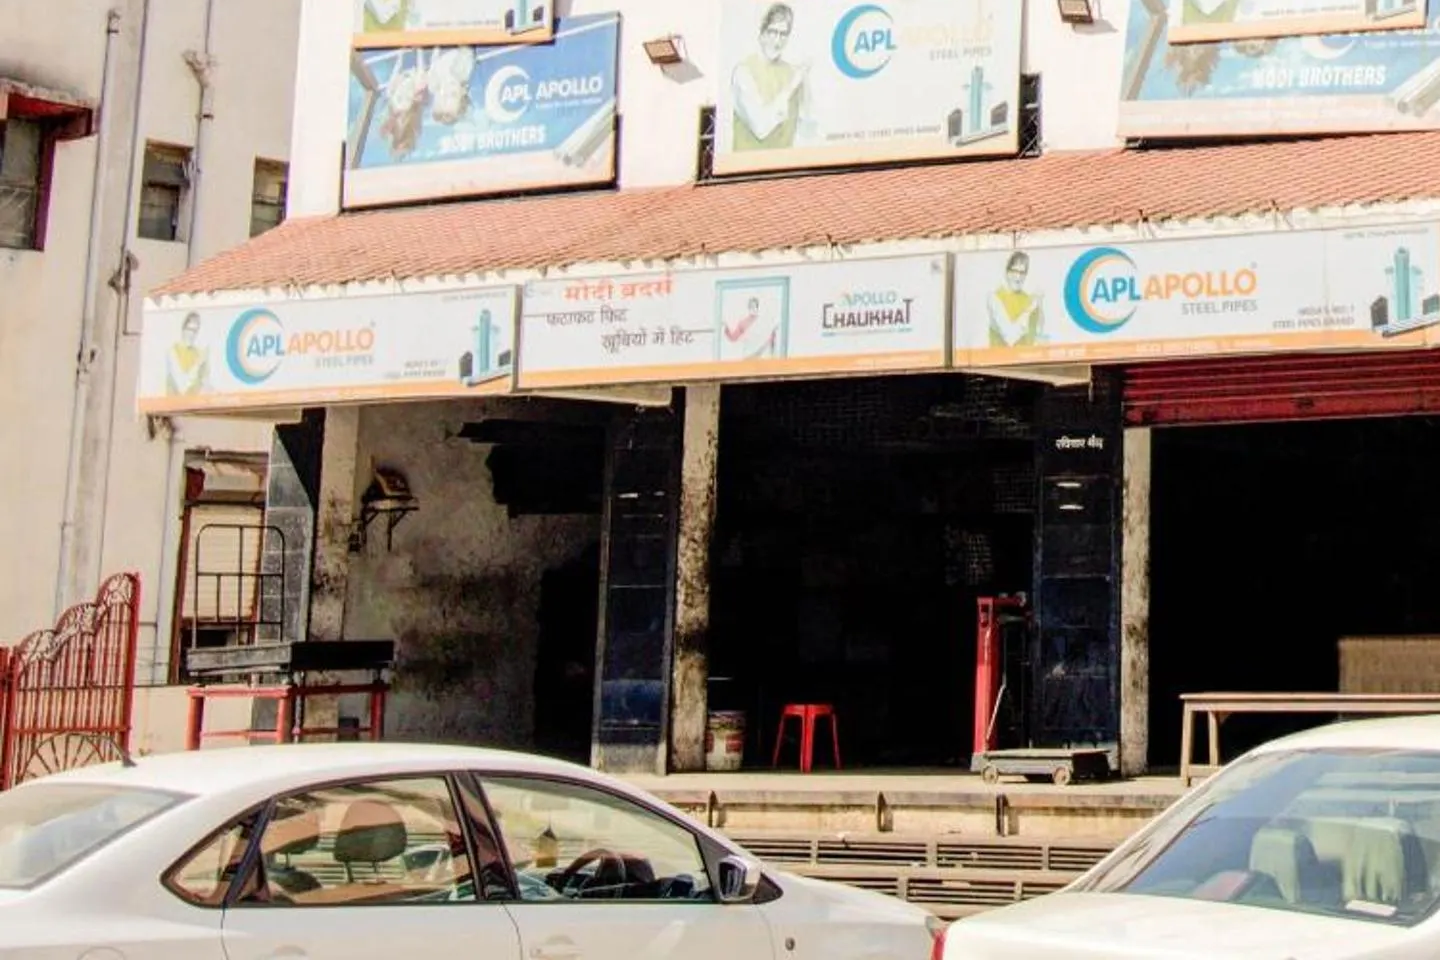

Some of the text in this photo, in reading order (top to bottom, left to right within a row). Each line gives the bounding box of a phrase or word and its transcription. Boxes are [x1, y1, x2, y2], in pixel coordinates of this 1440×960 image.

[853, 28, 897, 53] APL
[1300, 65, 1386, 86] BROTHERS
[502, 83, 532, 103] APL
[536, 76, 603, 99] APOLLO
[478, 125, 545, 150] BROTHERS
[564, 276, 613, 302] मोदी
[841, 289, 898, 307] APOLLO
[1090, 267, 1258, 304] APL APOLLO
[822, 299, 914, 329] CHAUKHAT
[1181, 300, 1258, 316] STEEL PIPES
[246, 328, 375, 359] APL APOLLO
